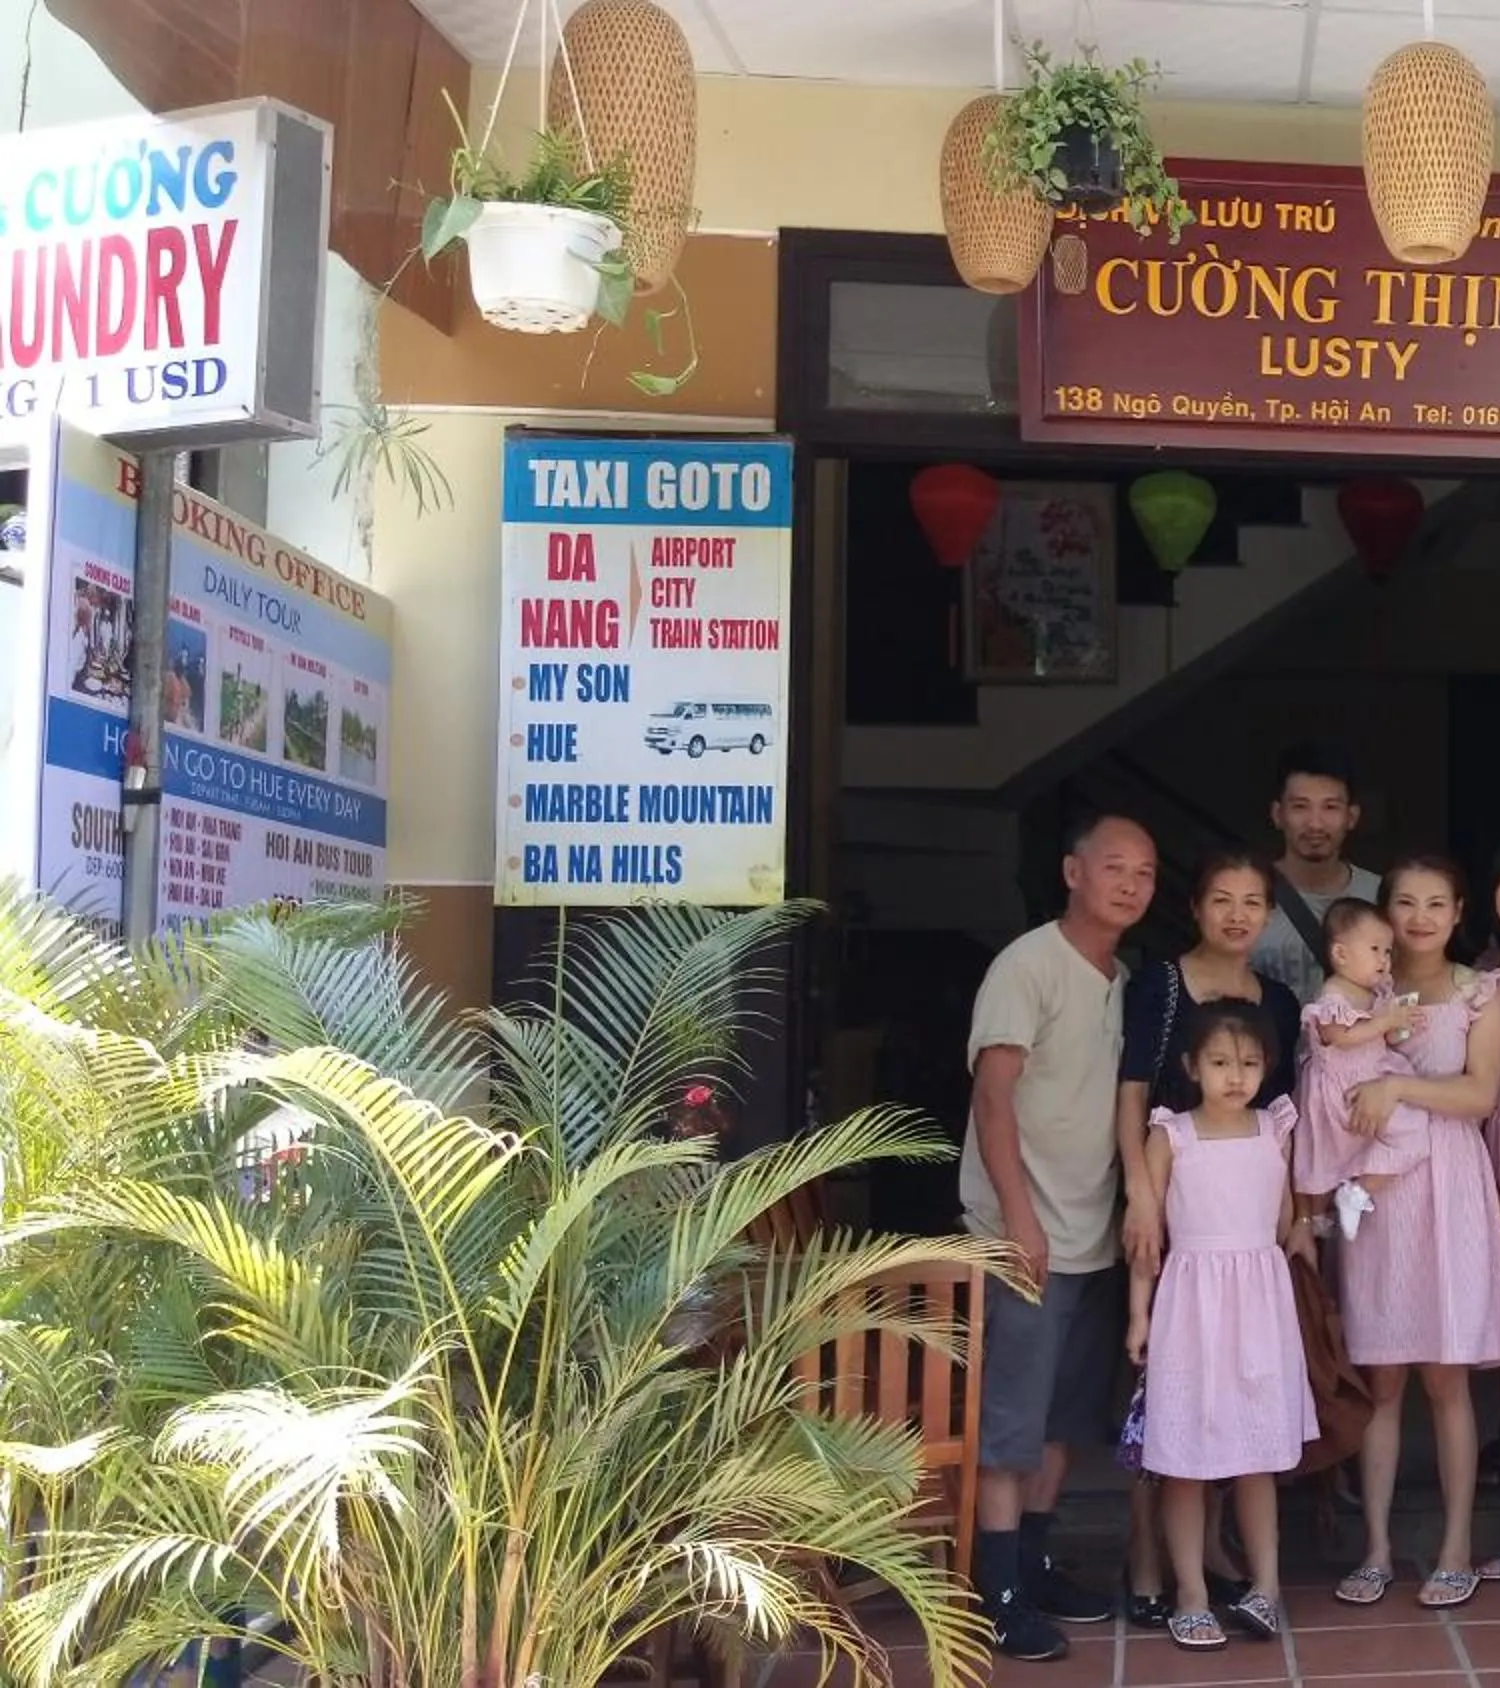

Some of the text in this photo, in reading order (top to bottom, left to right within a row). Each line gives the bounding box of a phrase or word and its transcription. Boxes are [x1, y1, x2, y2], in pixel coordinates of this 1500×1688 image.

[1201, 196, 1263, 229] LƯU
[1275, 200, 1336, 233] TRÚ
[0, 219, 238, 369] UNDRY
[1095, 243, 1341, 324] CƯỜNG
[125, 356, 228, 405] USD
[1260, 335, 1420, 381] LUSTY
[1055, 385, 1103, 412] 138
[1113, 393, 1162, 418] Ngô
[1266, 399, 1301, 423] Tp.
[1311, 397, 1349, 426] Hội
[1360, 404, 1391, 423] An
[1414, 403, 1452, 425] Tel:
[528, 459, 770, 512] TAXI GOTO
[117, 458, 366, 621] BOKING OFFICE
[547, 532, 597, 582] DA
[651, 537, 736, 568] AIRPORT
[203, 564, 302, 636] DAILY TOUR
[651, 577, 696, 608] CITY
[521, 598, 619, 649] NANG
[650, 618, 779, 650] TRAIN STATION
[528, 664, 630, 702] MY SON
[527, 724, 577, 763] HUE
[163, 741, 179, 772] N
[184, 749, 215, 781] GO
[219, 757, 246, 790] TO
[251, 769, 285, 801] HUE
[288, 778, 332, 811] EVERY
[335, 792, 361, 822] DAY
[525, 784, 773, 825] MARBLE MOUNTAIN
[265, 831, 372, 878] HOI AN BUS TOUR
[523, 845, 682, 885] BA NA HILLS
